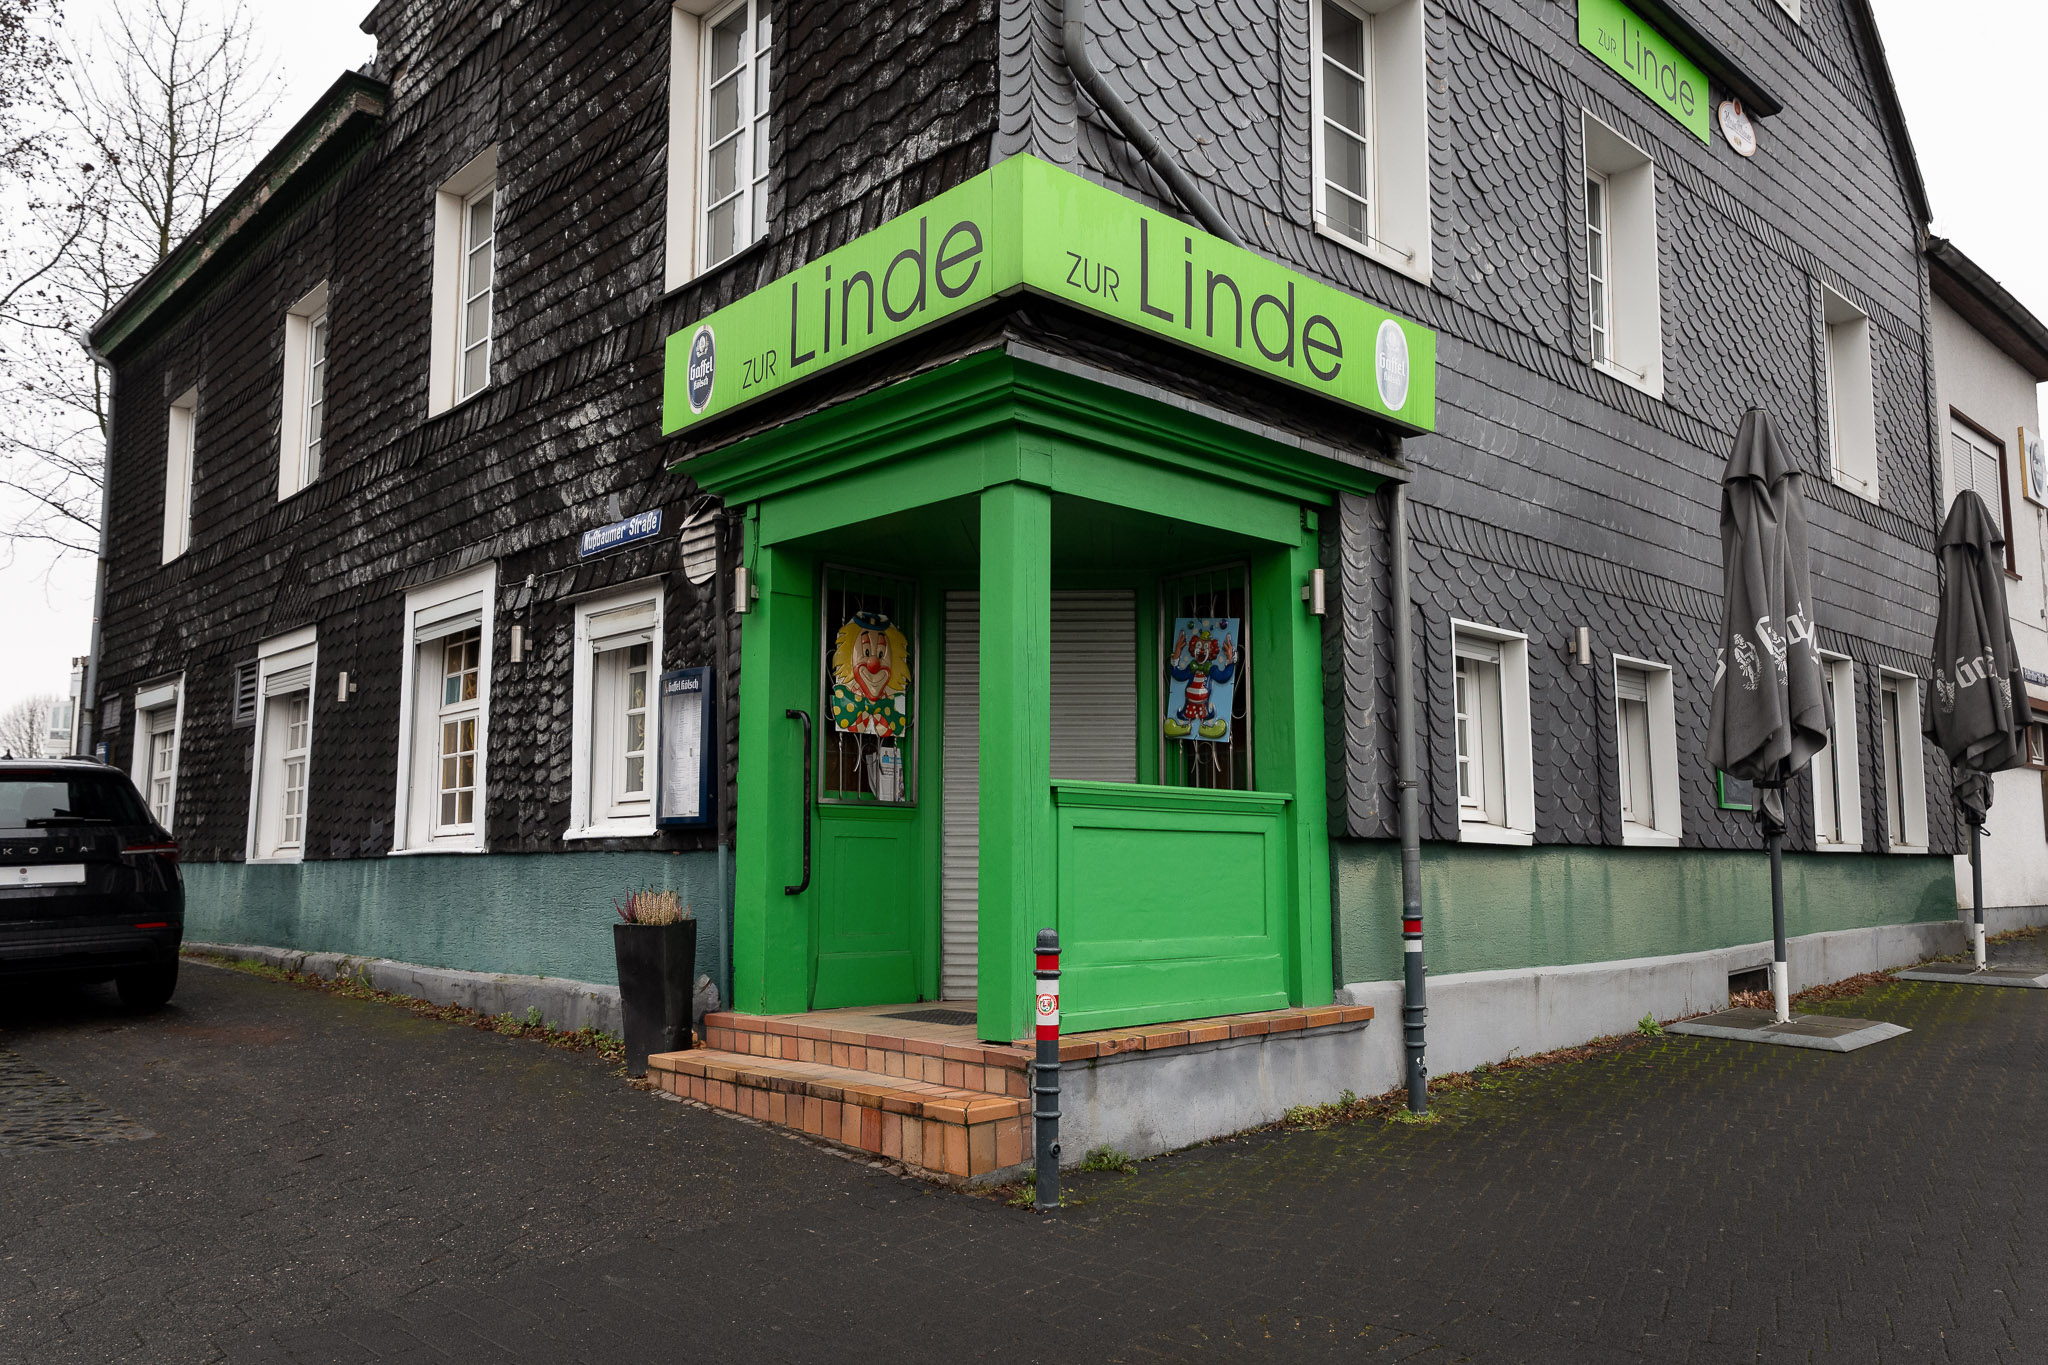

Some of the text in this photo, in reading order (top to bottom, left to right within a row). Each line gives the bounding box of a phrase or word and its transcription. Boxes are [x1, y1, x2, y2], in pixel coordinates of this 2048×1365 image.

[1598, 18, 1695, 117] ZUR Linde
[742, 216, 983, 390] ZUR Linde
[1066, 217, 1343, 382] ZUR Linde
[690, 356, 713, 381] Gaffel
[1380, 352, 1406, 377] Gaffel
[583, 511, 658, 552] Nußbaumer Straße
